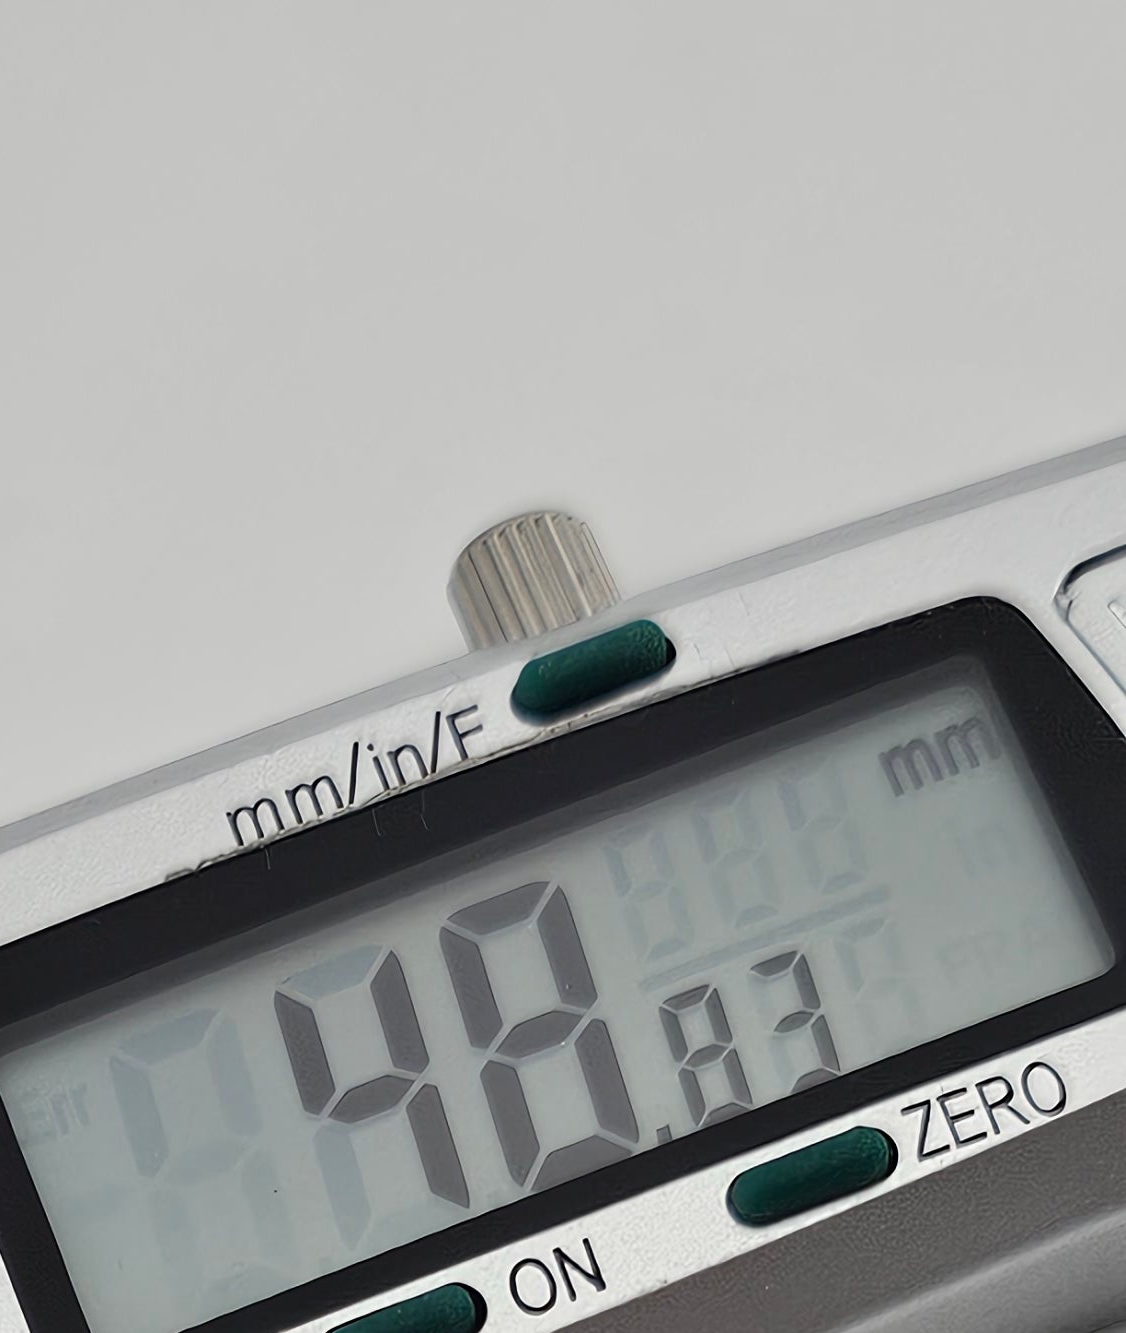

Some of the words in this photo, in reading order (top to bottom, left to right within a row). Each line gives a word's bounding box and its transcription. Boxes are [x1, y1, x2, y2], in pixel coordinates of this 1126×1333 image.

[225, 703, 484, 848] mm/in/F
[877, 716, 1003, 798] mm
[900, 1060, 1067, 1163] ZERO
[508, 1237, 607, 1317] ON
